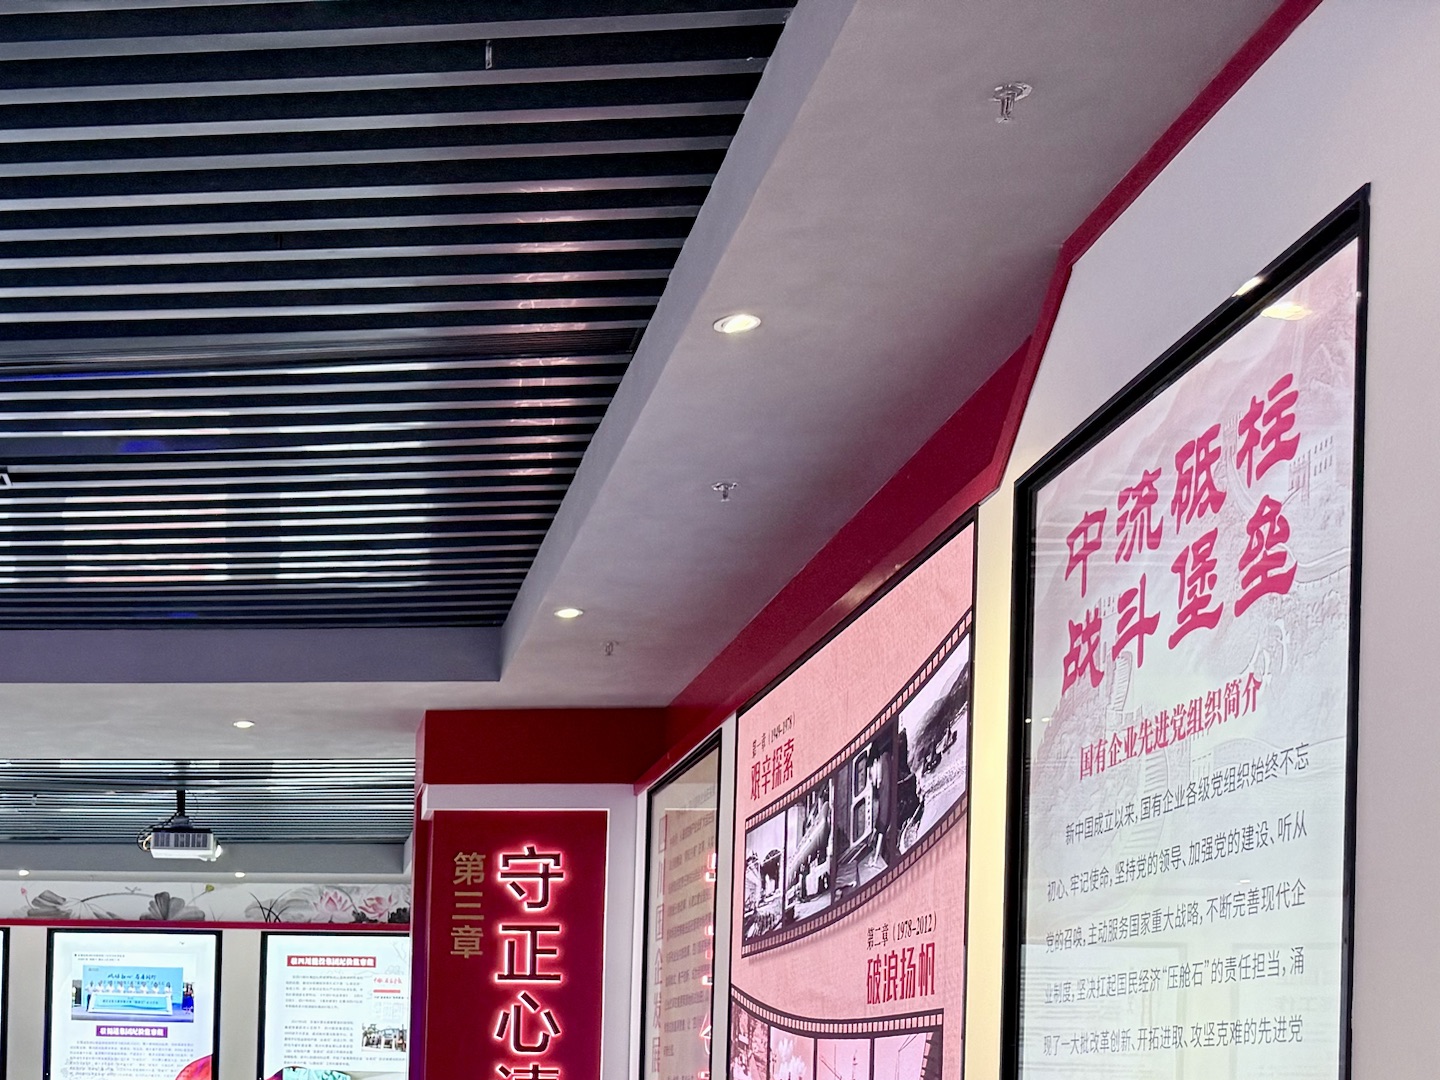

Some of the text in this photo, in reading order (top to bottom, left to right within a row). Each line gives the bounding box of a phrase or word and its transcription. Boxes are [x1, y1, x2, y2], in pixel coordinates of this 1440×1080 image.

[1065, 373, 1300, 598] 中流砥柱
[1062, 494, 1297, 695] 战斗堡垒
[1080, 672, 1261, 780] 国有企业先进党组织简介
[450, 851, 486, 959] 第三章
[866, 942, 935, 1004] 破浪扬帆
